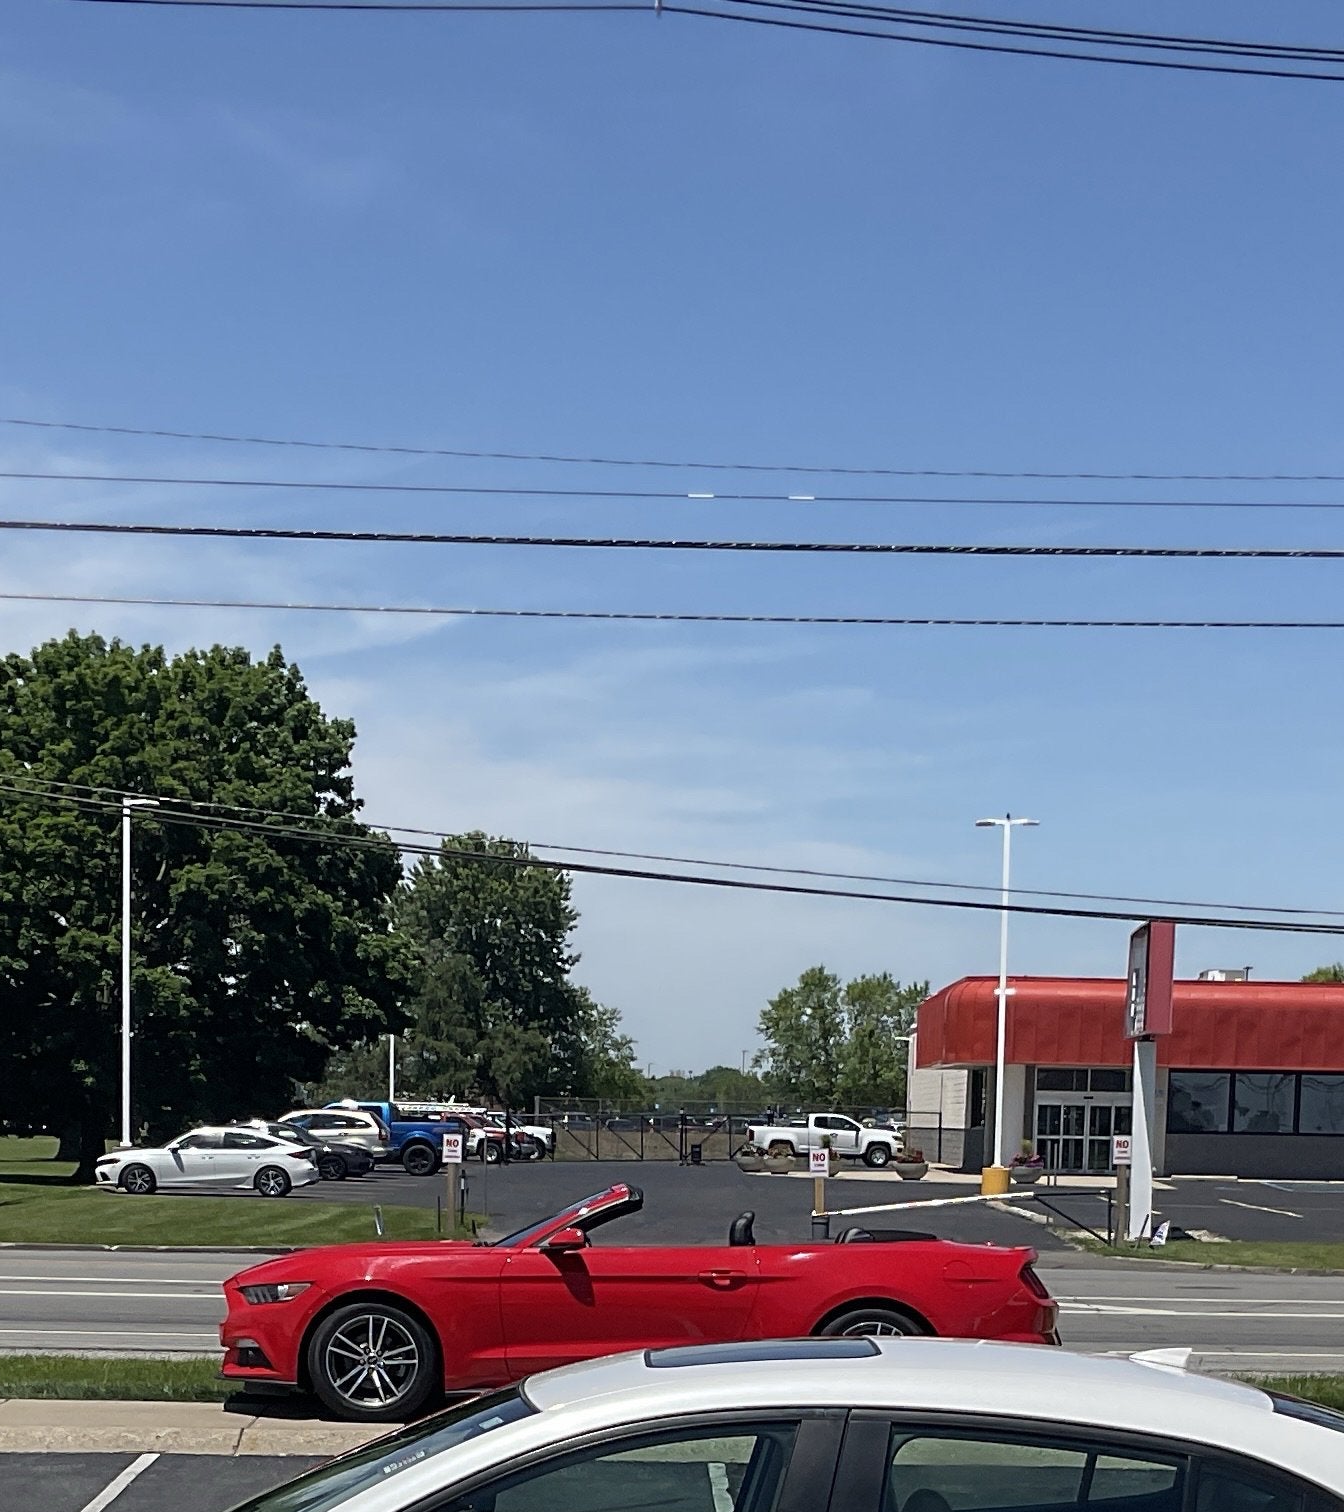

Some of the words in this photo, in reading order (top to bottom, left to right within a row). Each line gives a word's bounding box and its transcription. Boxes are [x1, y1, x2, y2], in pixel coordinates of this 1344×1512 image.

[446, 1139, 459, 1148] NO
[1116, 1140, 1129, 1149] NO
[812, 1153, 826, 1162] NO
